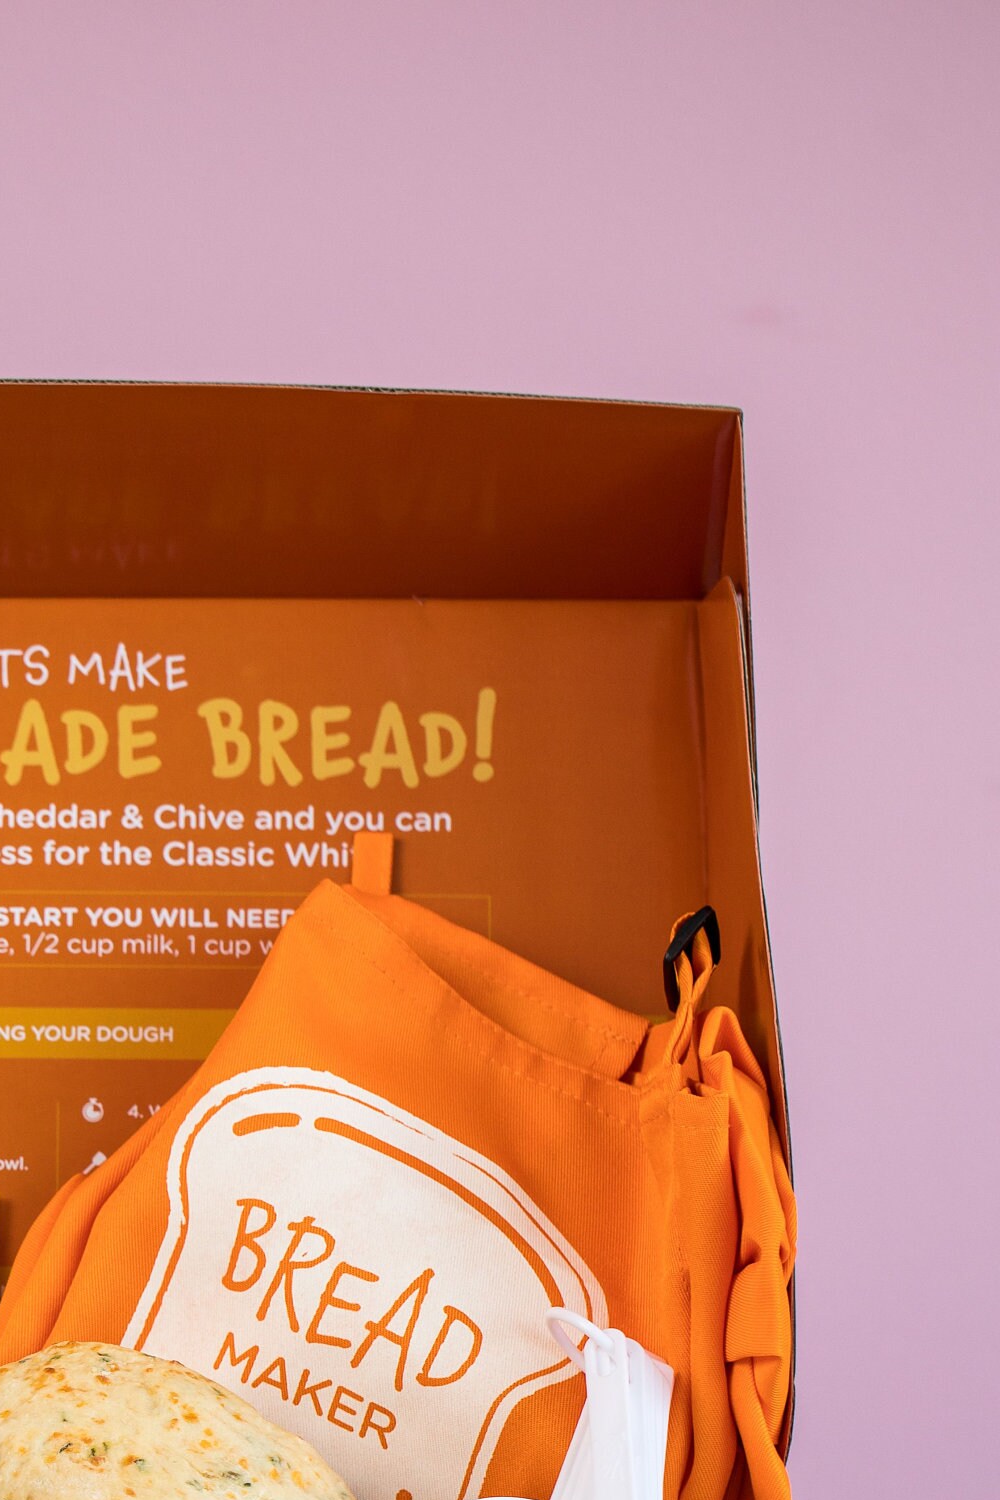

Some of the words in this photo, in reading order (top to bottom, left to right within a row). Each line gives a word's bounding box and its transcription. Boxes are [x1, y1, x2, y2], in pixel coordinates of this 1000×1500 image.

[67, 642, 188, 692] MAKE
[196, 687, 496, 788] BREAD!
[120, 804, 143, 830] &
[153, 803, 245, 831] Chive
[254, 805, 315, 831] and
[325, 811, 385, 836] you
[394, 811, 453, 833] can
[42, 839, 90, 866] for
[99, 839, 152, 867] the
[162, 840, 274, 867] Classic
[284, 842, 354, 868] Whi
[84, 906, 143, 928] YOU
[150, 907, 219, 928] WILL
[22, 931, 60, 957] 1/2
[66, 935, 114, 957] cup
[121, 933, 180, 957] milk,
[186, 934, 197, 955] 1
[203, 938, 251, 959] cup
[30, 1025, 91, 1042] YOUR
[95, 1026, 174, 1043] DOUGH
[221, 1198, 483, 1392] BREAD
[212, 1331, 397, 1450] MAKER
